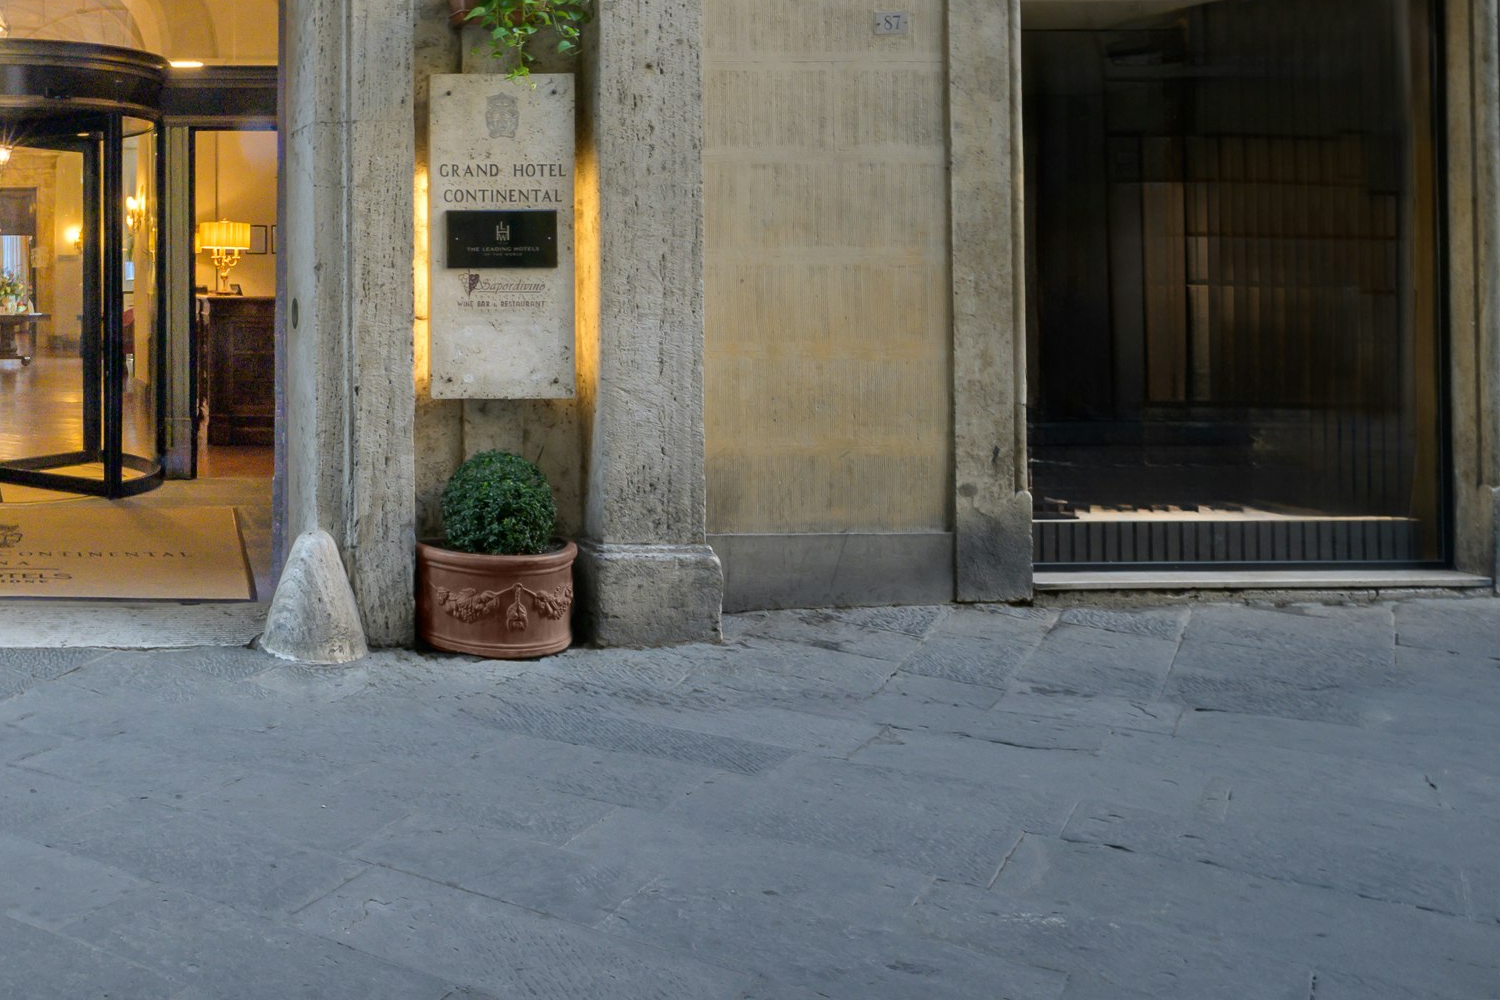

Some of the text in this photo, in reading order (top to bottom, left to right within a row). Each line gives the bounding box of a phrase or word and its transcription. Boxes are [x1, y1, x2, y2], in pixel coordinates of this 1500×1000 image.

[883, 15, 901, 31] 87
[439, 163, 567, 178] GRAND HOTEL
[443, 188, 563, 203] CONTINENTAL
[457, 300, 474, 308] WINE
[477, 300, 491, 308] BAR
[500, 300, 546, 308] RESTAURANT
